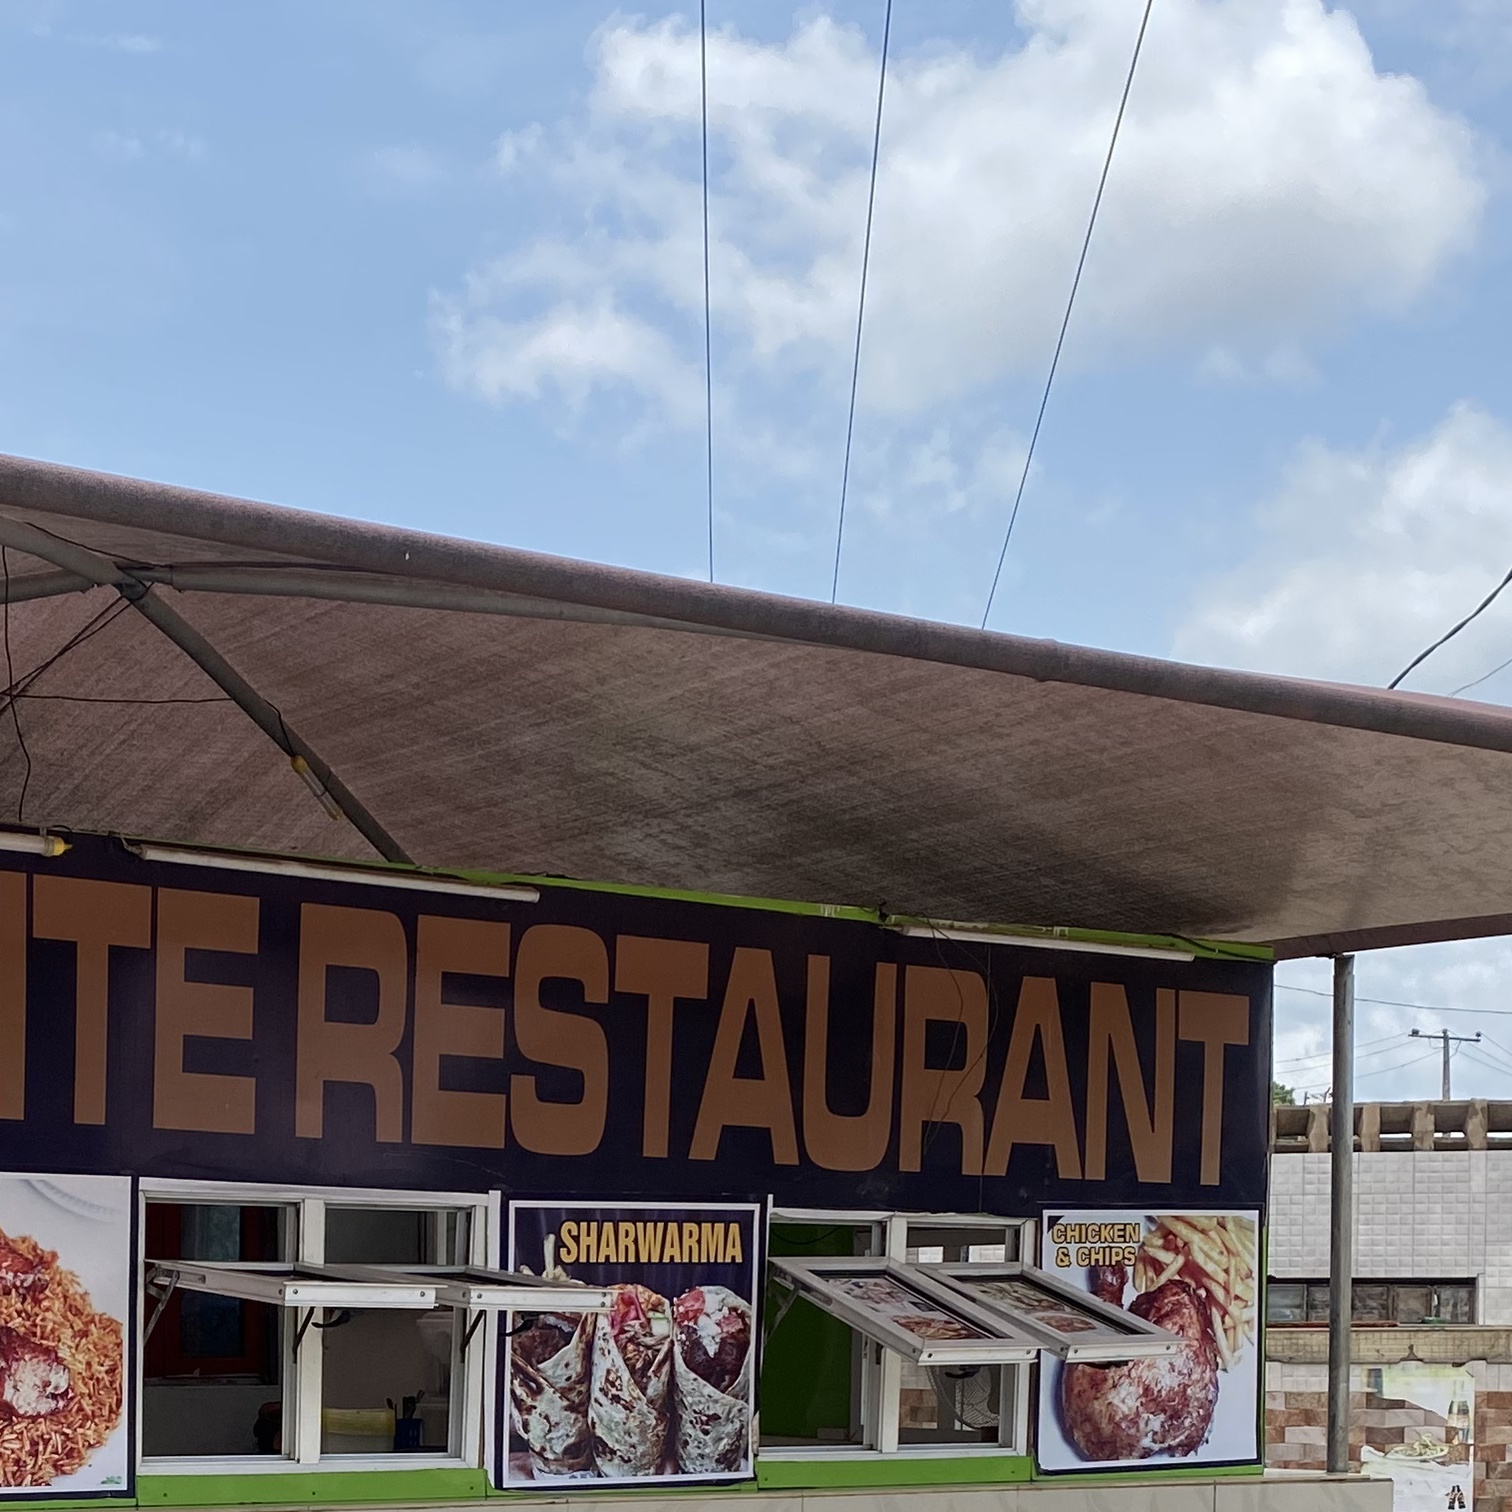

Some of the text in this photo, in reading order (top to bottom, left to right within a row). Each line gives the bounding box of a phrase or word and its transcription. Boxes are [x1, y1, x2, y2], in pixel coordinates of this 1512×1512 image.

[295, 902, 1250, 1186] RESTAURANT
[559, 1221, 743, 1263] SHARWARMA
[1052, 1223, 1140, 1244] CHICKEN
[1055, 1246, 1137, 1267] & CHIPS
